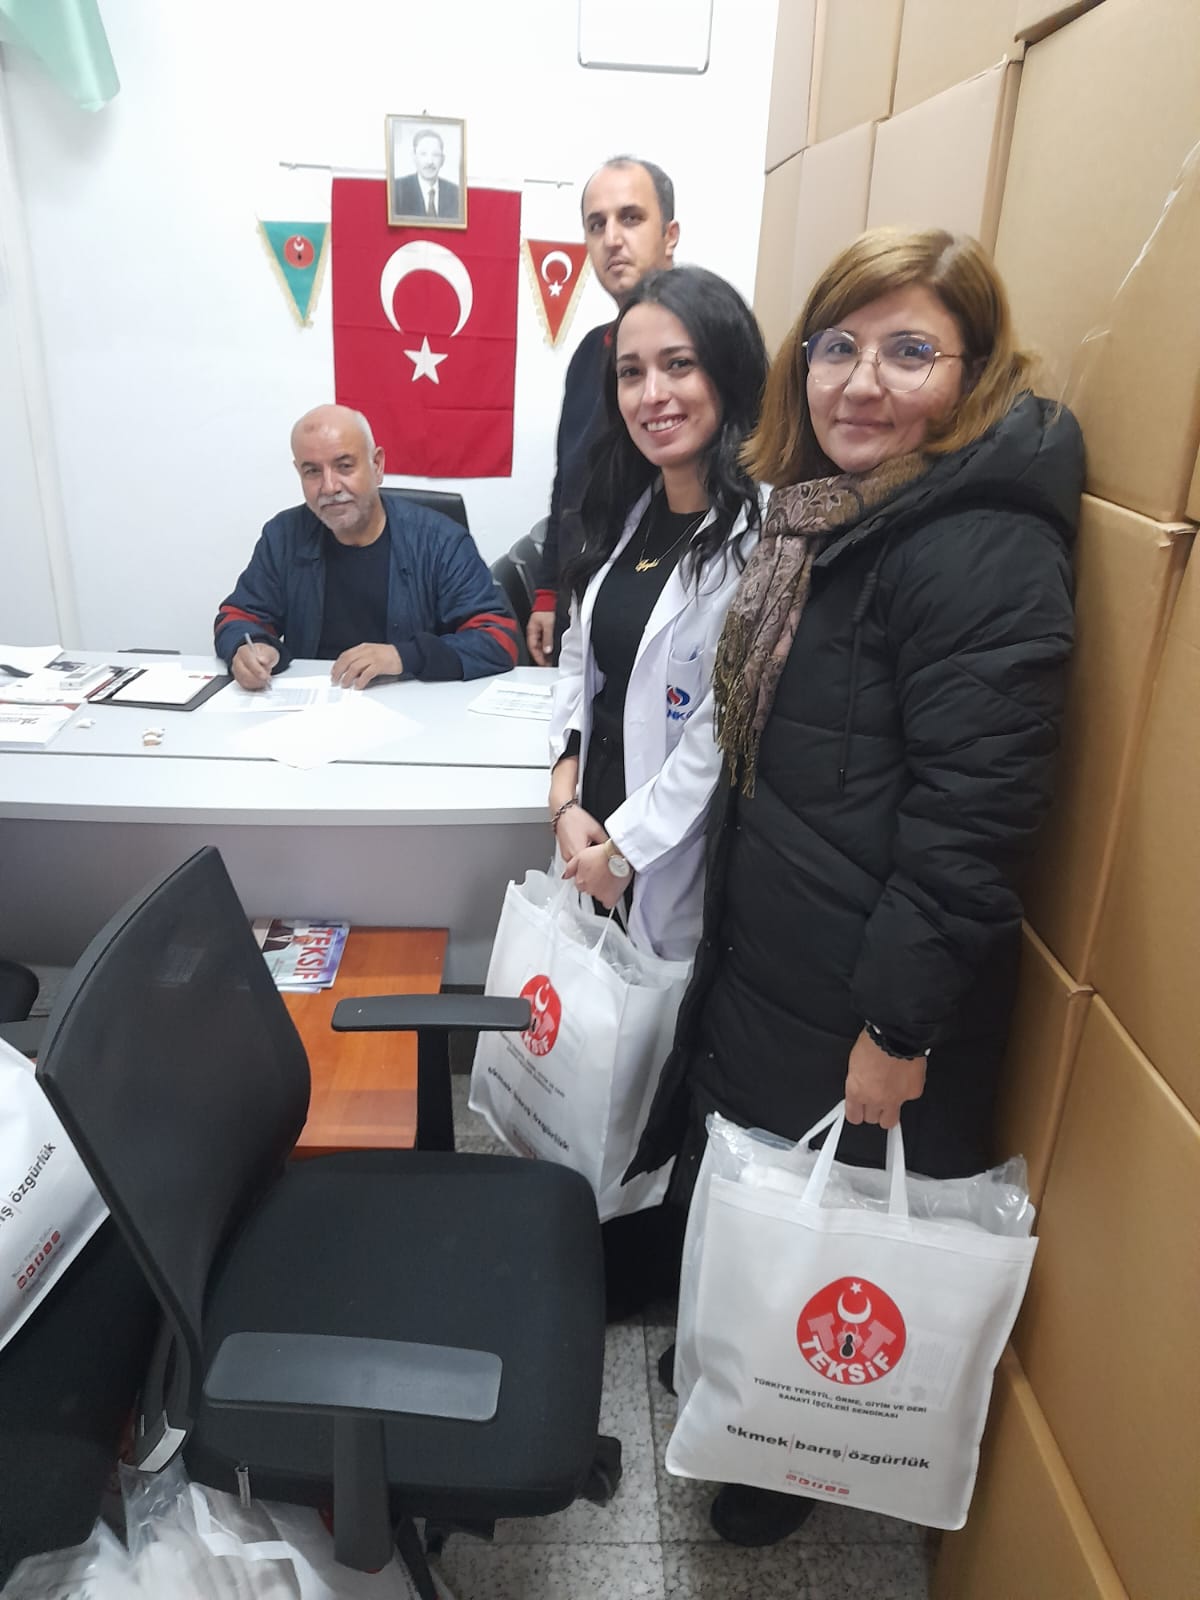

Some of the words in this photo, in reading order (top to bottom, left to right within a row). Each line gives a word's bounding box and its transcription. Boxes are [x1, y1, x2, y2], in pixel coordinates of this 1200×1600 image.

[8, 1141, 56, 1204] özgürlük
[726, 1424, 789, 1448] ekmek
[795, 1440, 842, 1458] barış
[848, 1450, 931, 1469] özgürlük
